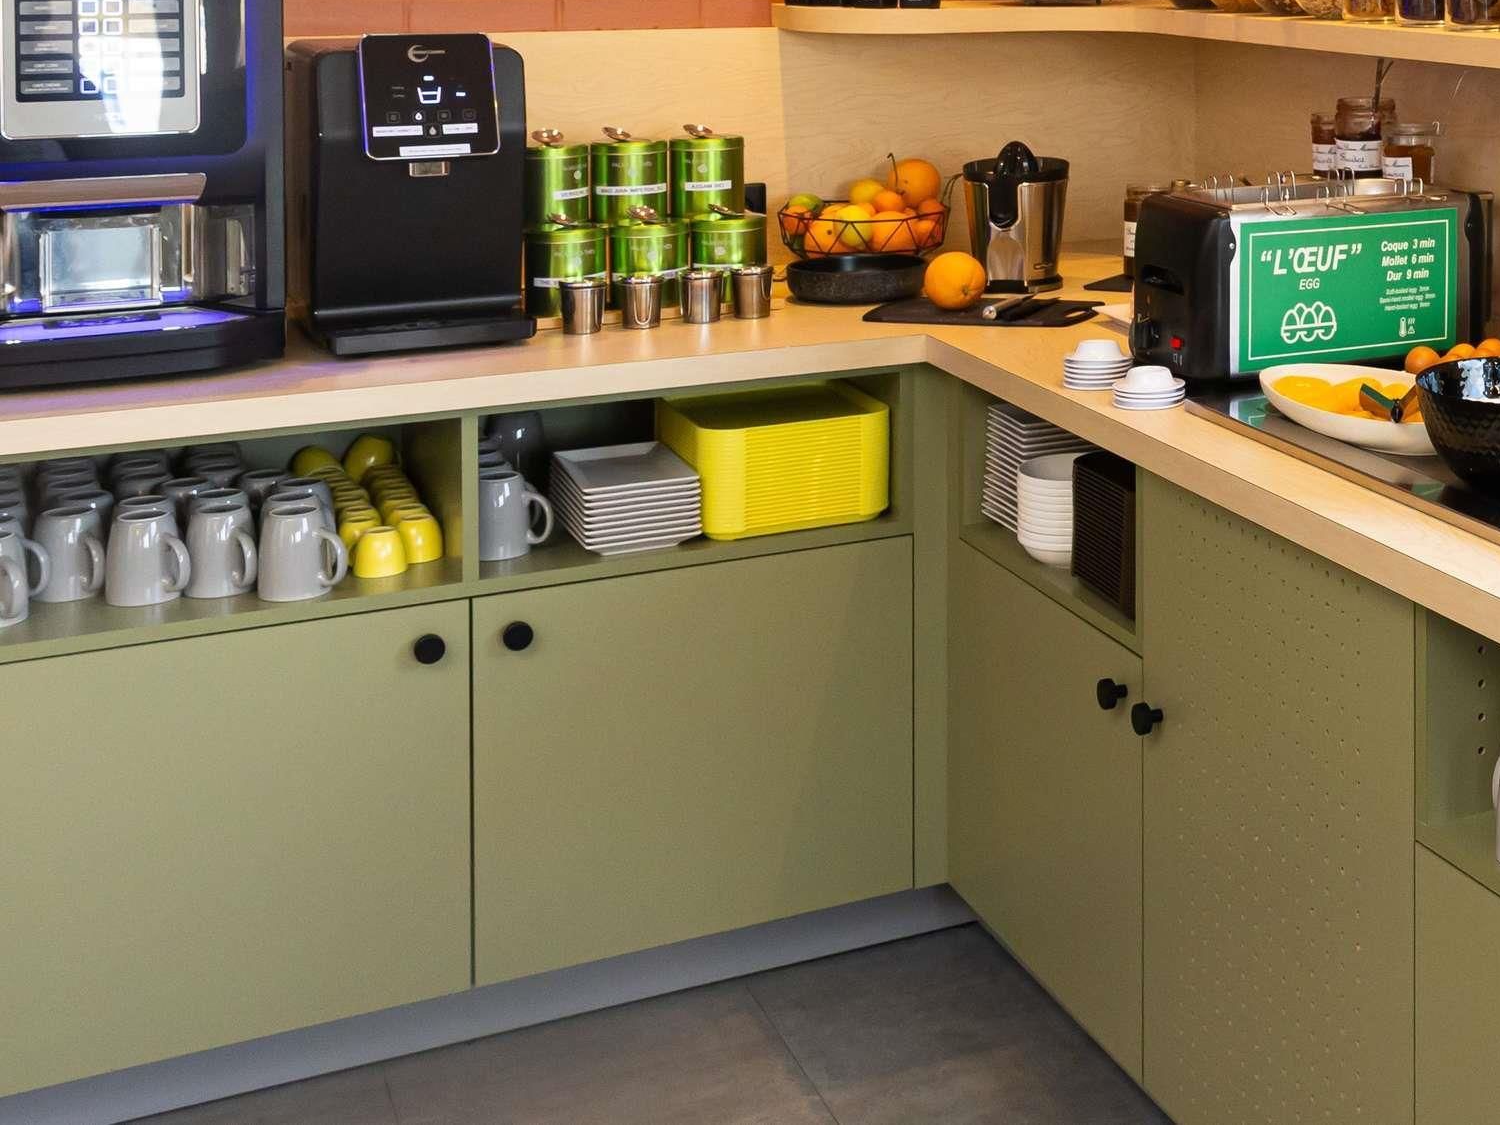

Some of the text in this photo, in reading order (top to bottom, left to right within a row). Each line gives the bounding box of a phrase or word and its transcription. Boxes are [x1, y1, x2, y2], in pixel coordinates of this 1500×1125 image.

[1381, 237, 1436, 253] Coque 3 min
[1381, 252, 1435, 267] Mollet 6 min
[1386, 267, 1430, 282] Dur 9 min
[1299, 277, 1320, 291] EGG
